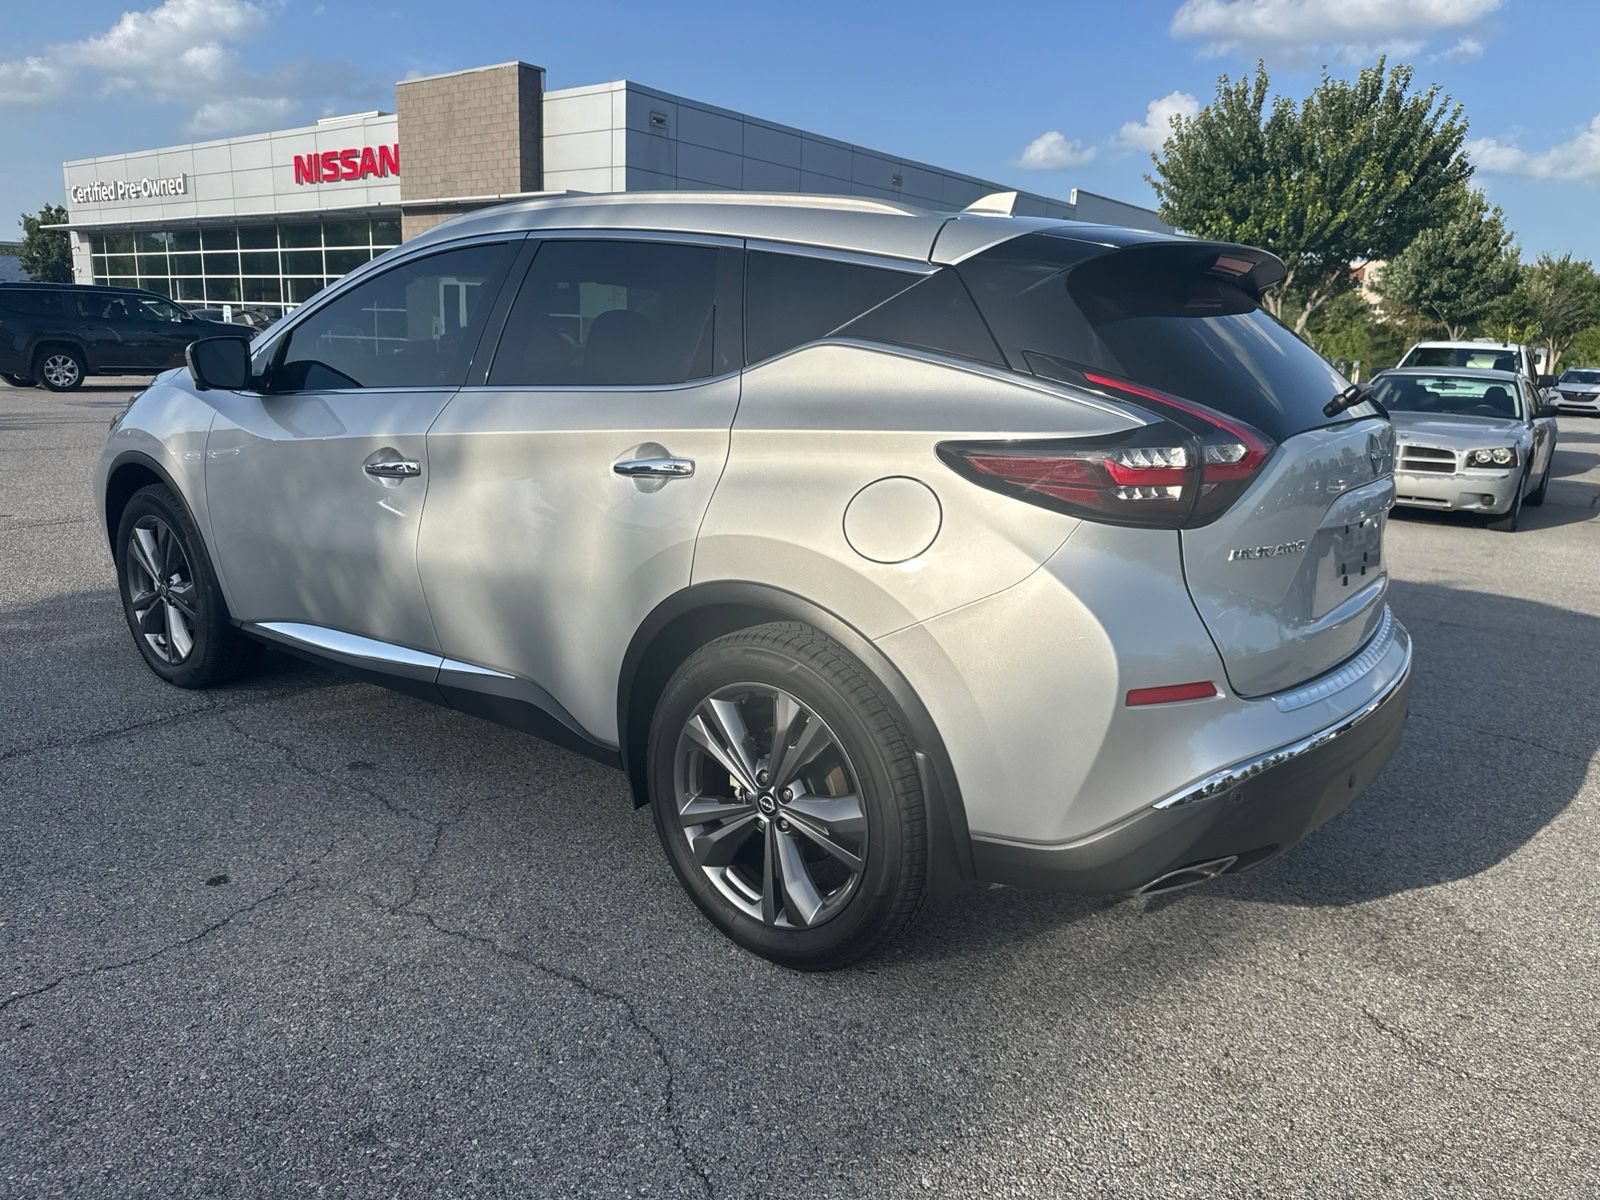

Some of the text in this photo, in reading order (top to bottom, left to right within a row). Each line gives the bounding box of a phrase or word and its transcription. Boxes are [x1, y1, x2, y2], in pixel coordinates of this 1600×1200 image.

[294, 144, 399, 184] NISSAN
[71, 172, 185, 203] Certified Pre-Owned
